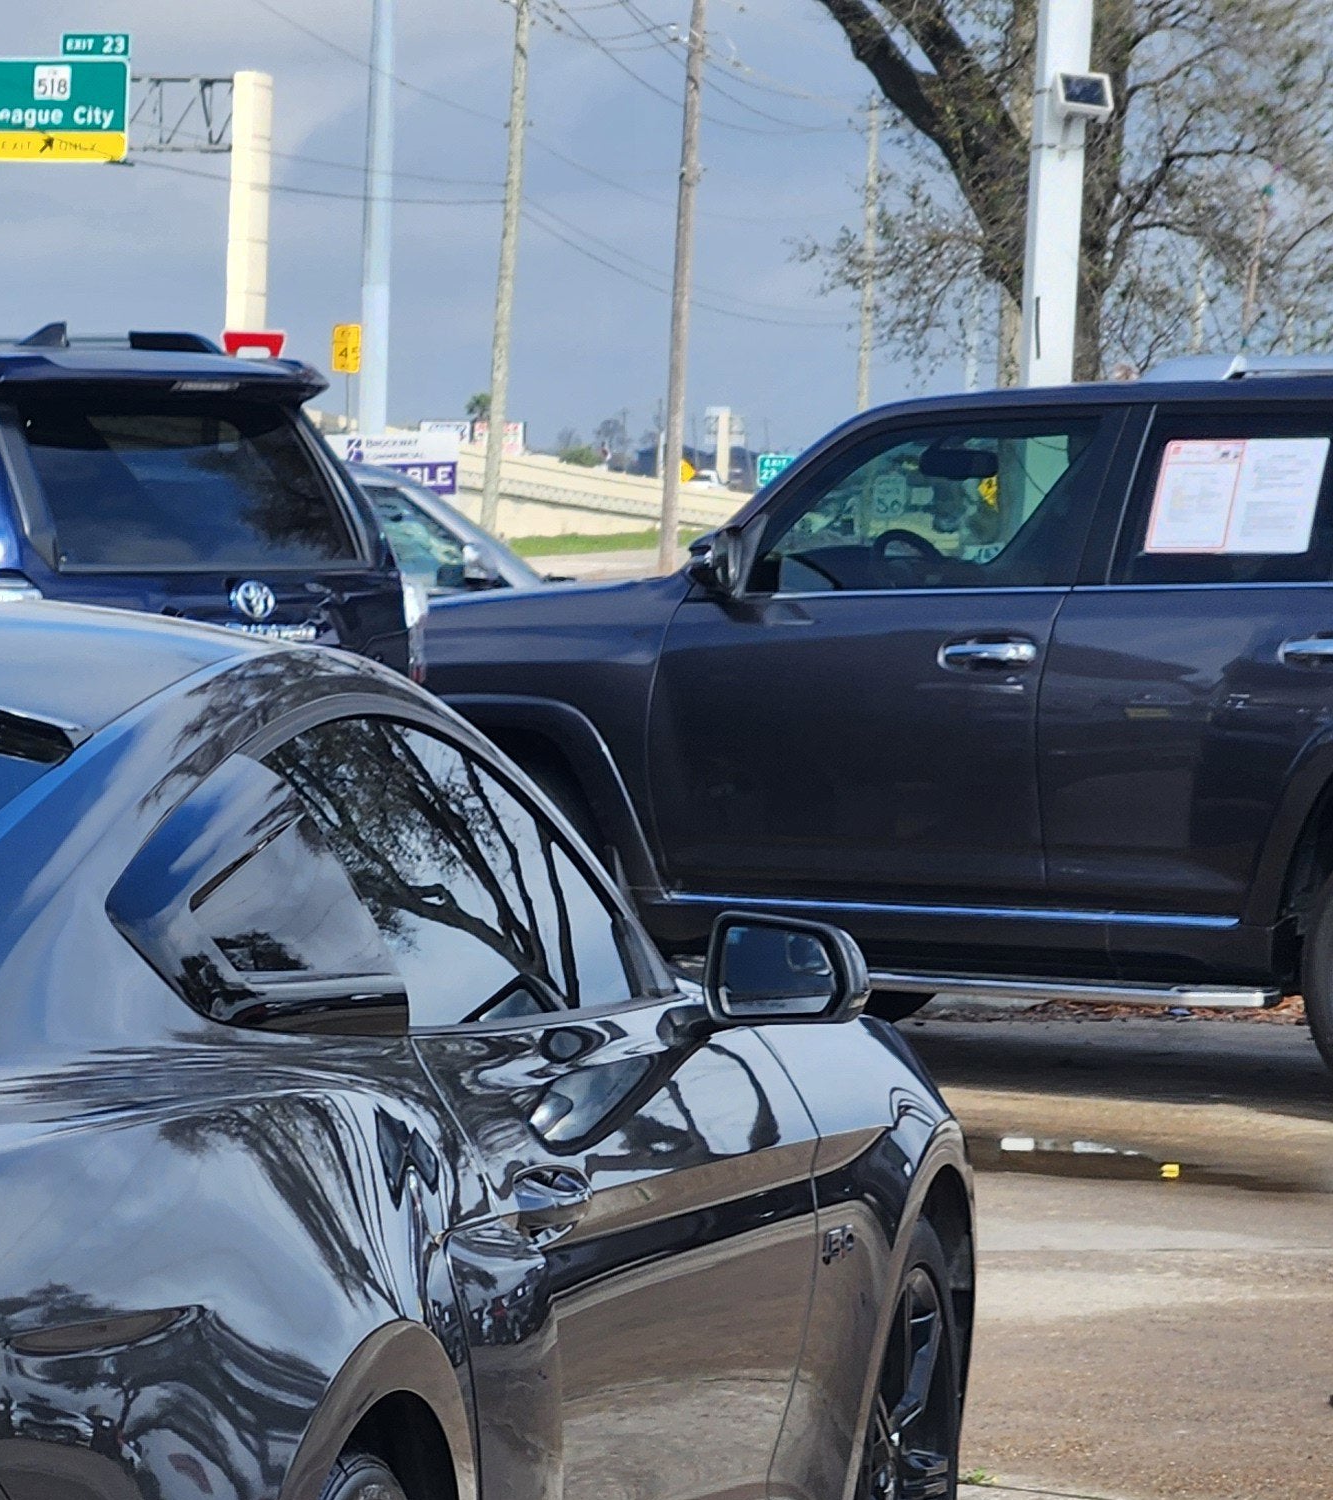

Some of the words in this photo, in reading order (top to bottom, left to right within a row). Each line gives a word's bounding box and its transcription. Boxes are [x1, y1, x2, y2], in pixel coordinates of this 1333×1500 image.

[65, 38, 94, 51] EXIT
[102, 35, 125, 53] 23
[37, 78, 68, 96] 518
[73, 105, 115, 129] City
